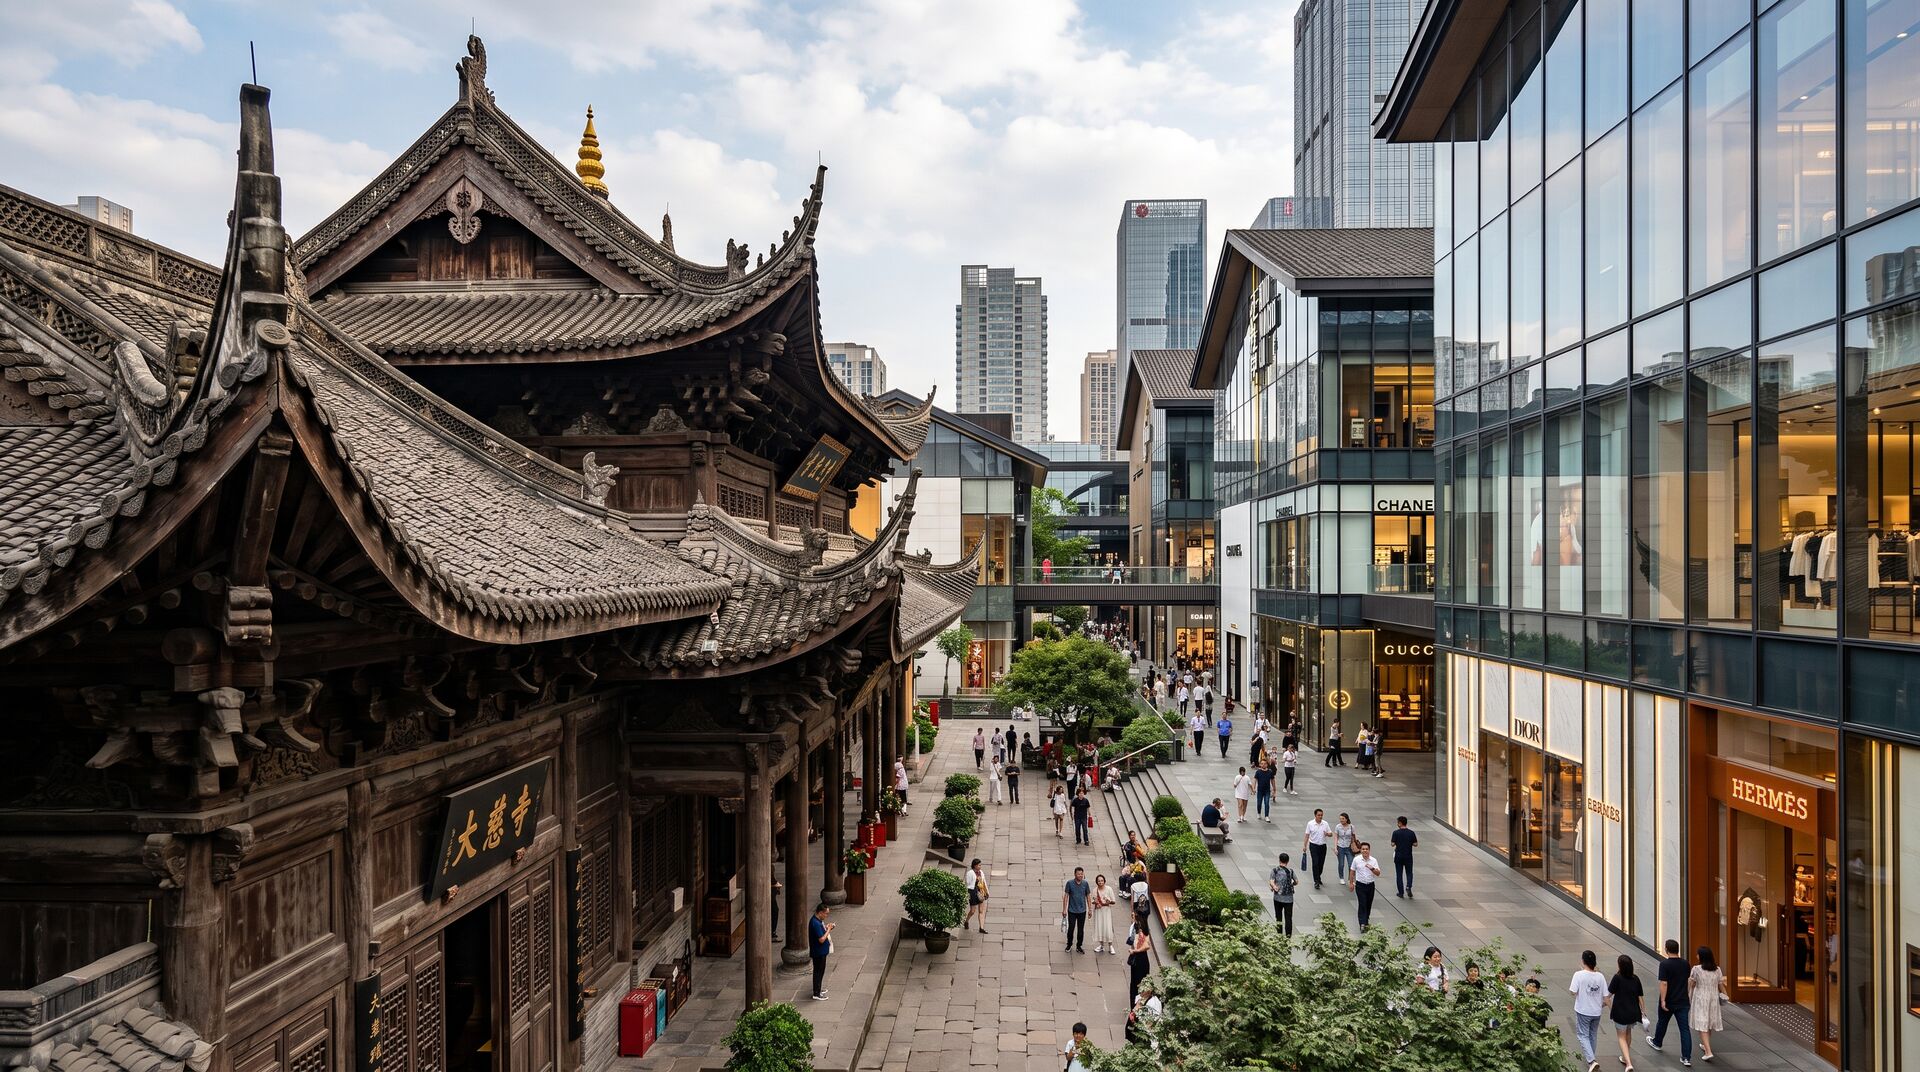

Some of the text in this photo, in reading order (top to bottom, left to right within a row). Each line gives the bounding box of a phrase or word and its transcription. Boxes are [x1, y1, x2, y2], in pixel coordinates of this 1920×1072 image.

[1514, 718, 1540, 743] DIOR
[1732, 777, 1808, 820] HERMÈS
[452, 783, 532, 868] 大慈寺
